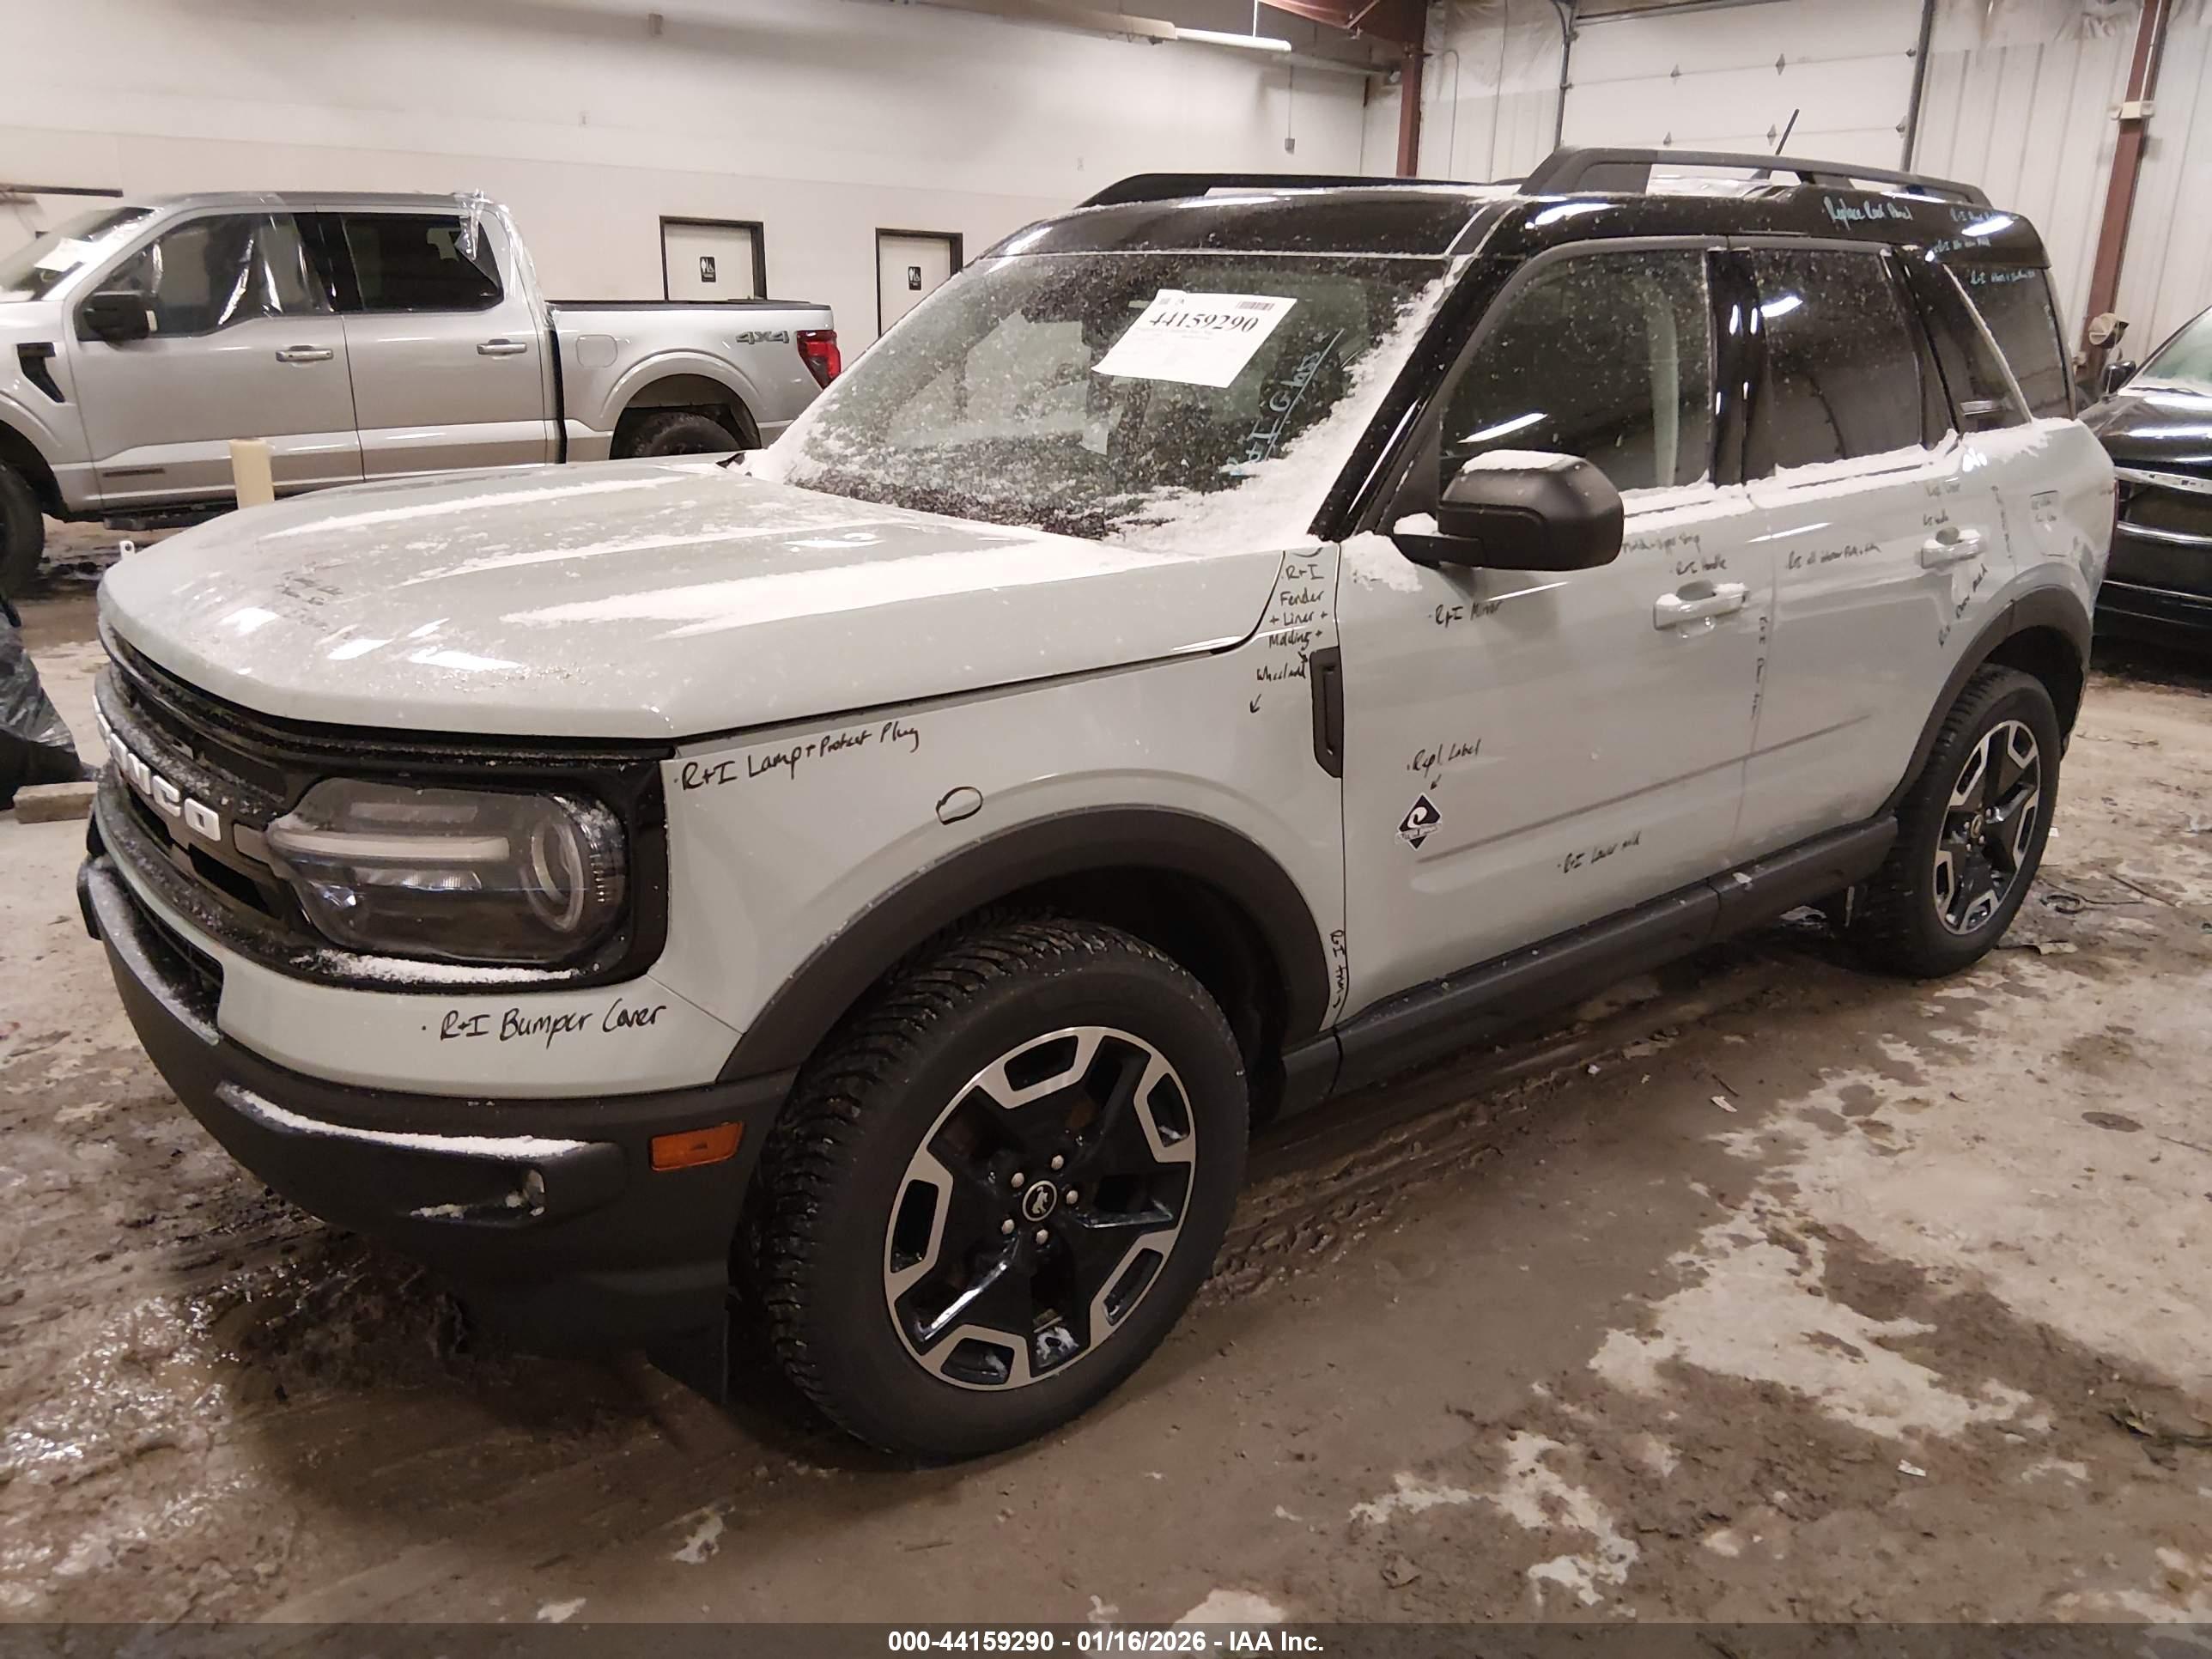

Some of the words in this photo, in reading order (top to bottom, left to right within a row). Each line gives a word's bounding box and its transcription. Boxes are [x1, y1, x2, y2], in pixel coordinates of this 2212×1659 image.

[1149, 311, 1260, 333] 44159290
[1280, 587, 1324, 606] Fender
[747, 746, 802, 780] Lamp
[879, 720, 920, 753] Plug
[499, 1007, 593, 1049] Bumper
[602, 997, 667, 1032] Cover
